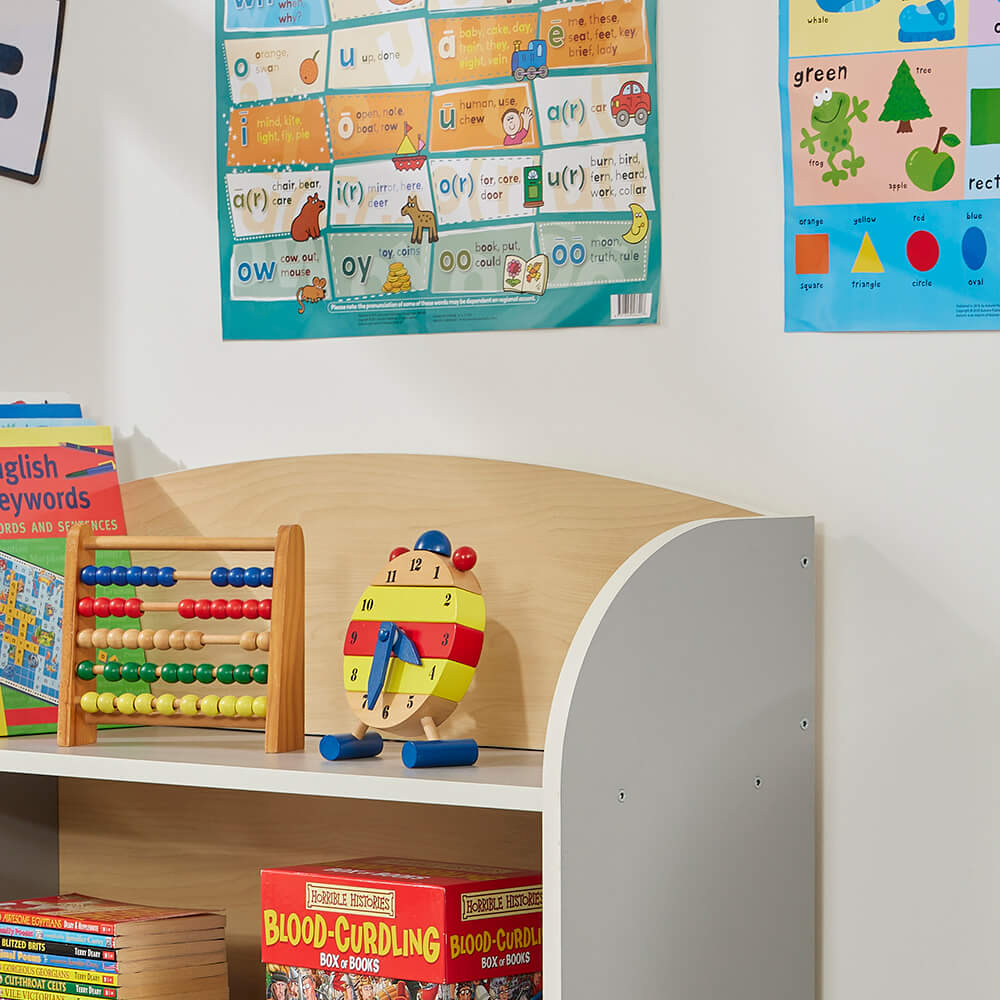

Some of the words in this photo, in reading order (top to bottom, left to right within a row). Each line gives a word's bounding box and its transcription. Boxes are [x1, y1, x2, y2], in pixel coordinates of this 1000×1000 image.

[589, 14, 620, 25] these,
[808, 16, 828, 25] whale
[378, 50, 400, 61] done
[596, 44, 618, 57] lady
[340, 48, 354, 68] u
[793, 65, 847, 88] green
[916, 66, 932, 75] tree
[460, 99, 496, 111] human,
[547, 99, 585, 126] a(r)
[591, 104, 608, 113] car
[460, 114, 485, 125] chew
[808, 158, 824, 168] frog
[548, 165, 585, 192] u(r)
[968, 176, 1000, 190] rect
[272, 180, 297, 192] chair,
[618, 184, 647, 196] collar
[888, 182, 908, 192] apple
[272, 196, 292, 206] care
[481, 190, 503, 200] door
[799, 216, 824, 227] orange
[853, 215, 876, 226] yellow
[913, 213, 925, 222] red
[966, 211, 982, 220] blue
[591, 236, 622, 248] moon,
[396, 246, 421, 256] coins
[620, 251, 639, 262] rule
[237, 261, 276, 281] ow
[280, 268, 311, 278] mouse
[342, 255, 372, 282] oy
[800, 282, 824, 292] square
[852, 280, 881, 290] triangle
[912, 278, 932, 288] circle
[968, 278, 984, 287] oval
[32, 520, 53, 532] AND
[410, 558, 422, 572] 12
[386, 570, 397, 582] 11
[433, 566, 440, 580] 1
[361, 599, 374, 612] 10
[444, 593, 452, 606] 2
[350, 631, 358, 645] 9
[441, 633, 450, 646] 3
[312, 889, 347, 906] HORRIBLE
[350, 892, 390, 910] HISTORIES
[3, 914, 31, 926] AWESOME
[32, 917, 62, 928] EGYPTIANS
[264, 909, 440, 964] BLOOD-CURDLING
[2, 938, 26, 950] BLITZED
[28, 940, 46, 952] BRITS
[74, 948, 87, 957] TERRY
[88, 949, 101, 958] DEARY
[320, 952, 340, 968] BOX
[349, 956, 380, 973] BOOKS
[36, 968, 70, 980] GEORGIANS
[4, 976, 46, 990] CUT-THROAT
[47, 981, 66, 992] CELTS
[5, 988, 24, 1000] VILE
